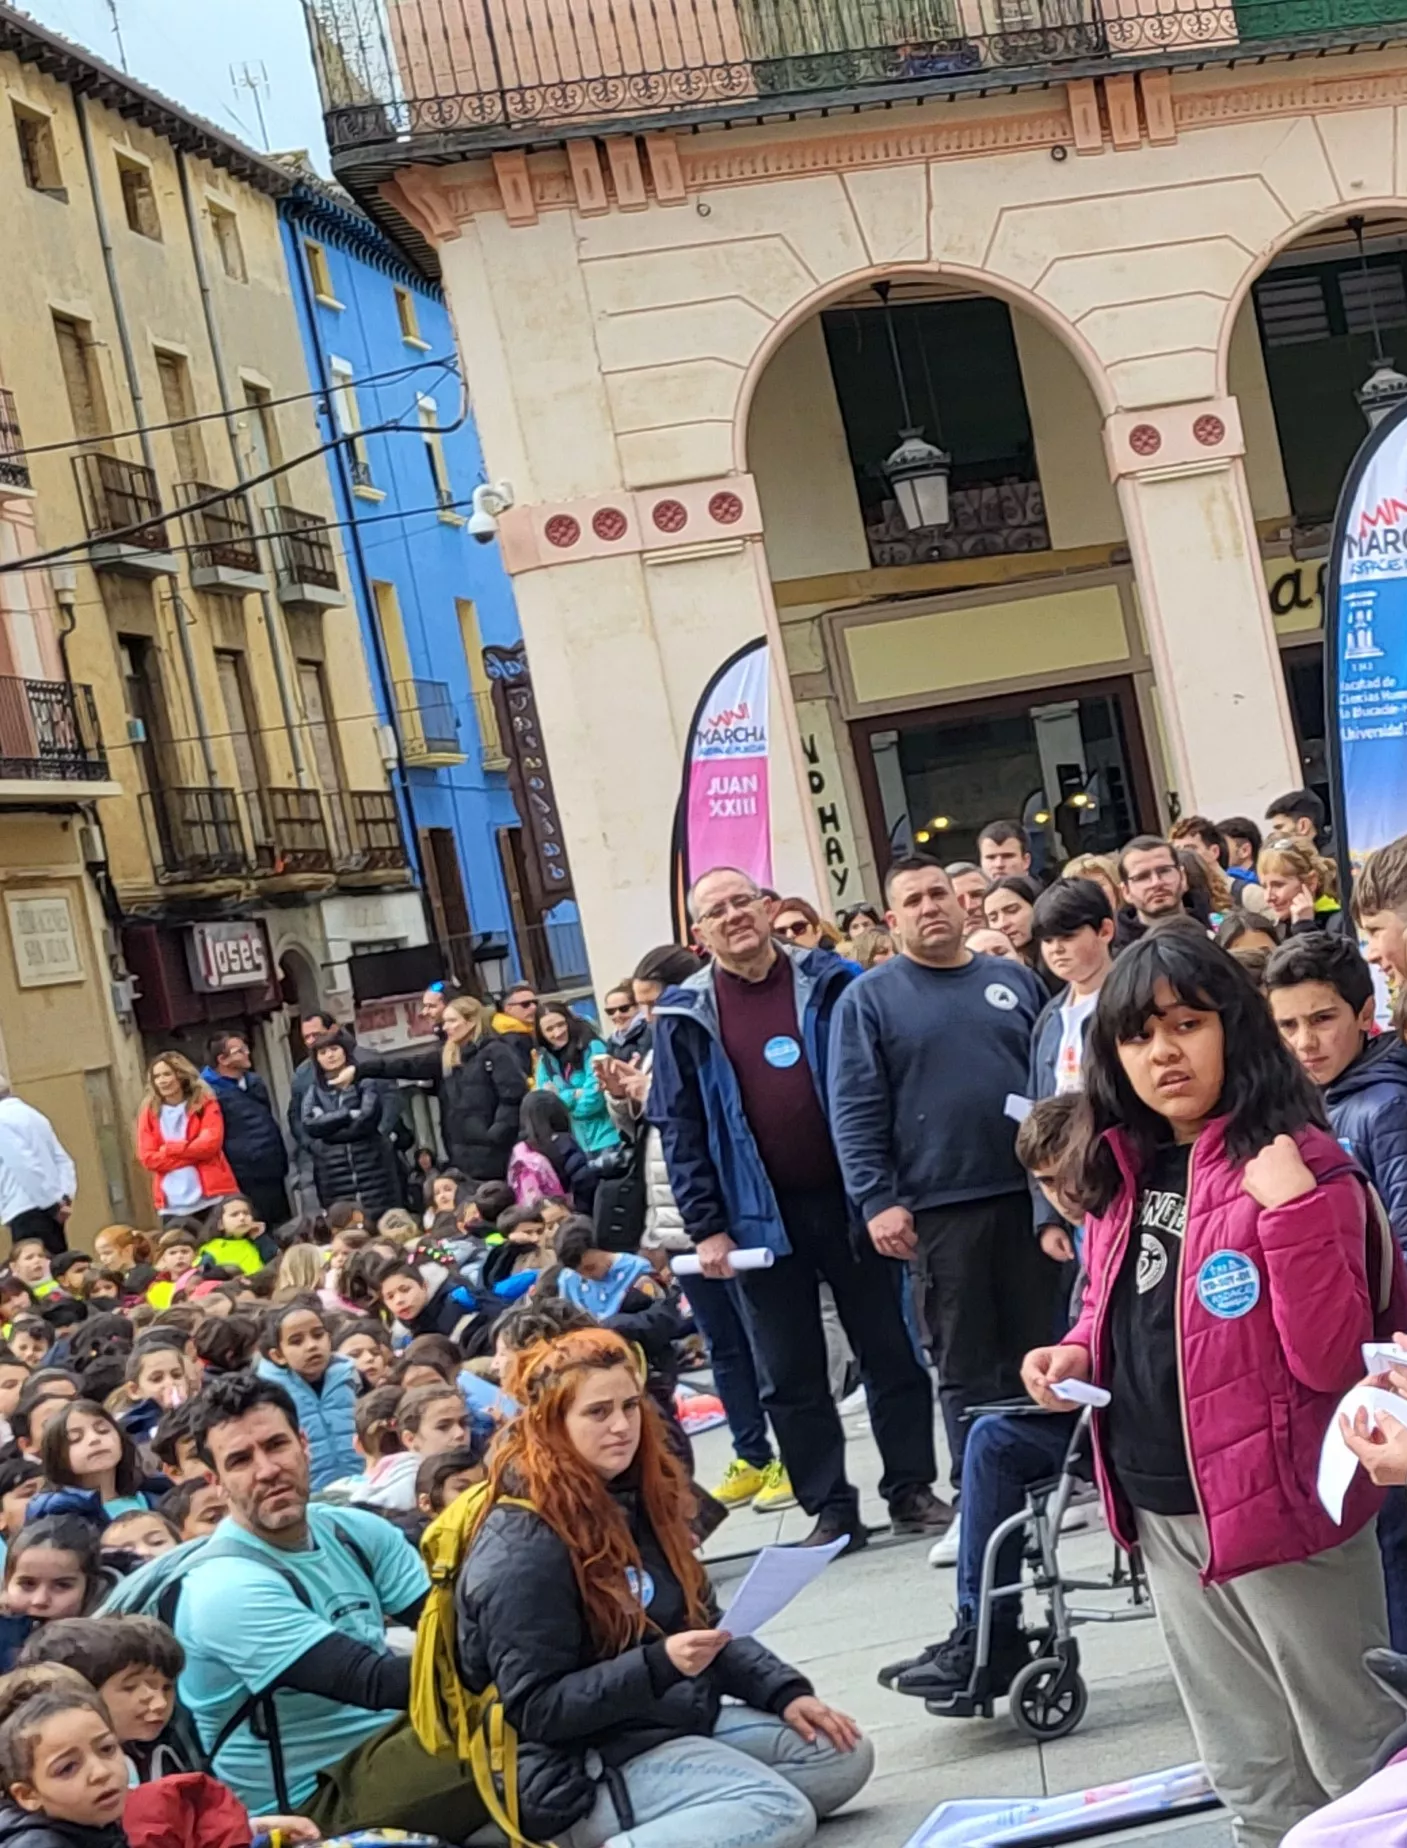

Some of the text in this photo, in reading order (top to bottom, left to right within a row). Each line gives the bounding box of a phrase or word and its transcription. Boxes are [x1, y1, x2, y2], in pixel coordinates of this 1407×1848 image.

[706, 774, 758, 796] JUAN
[708, 796, 758, 817] XXIII
[817, 802, 849, 896] HAY
